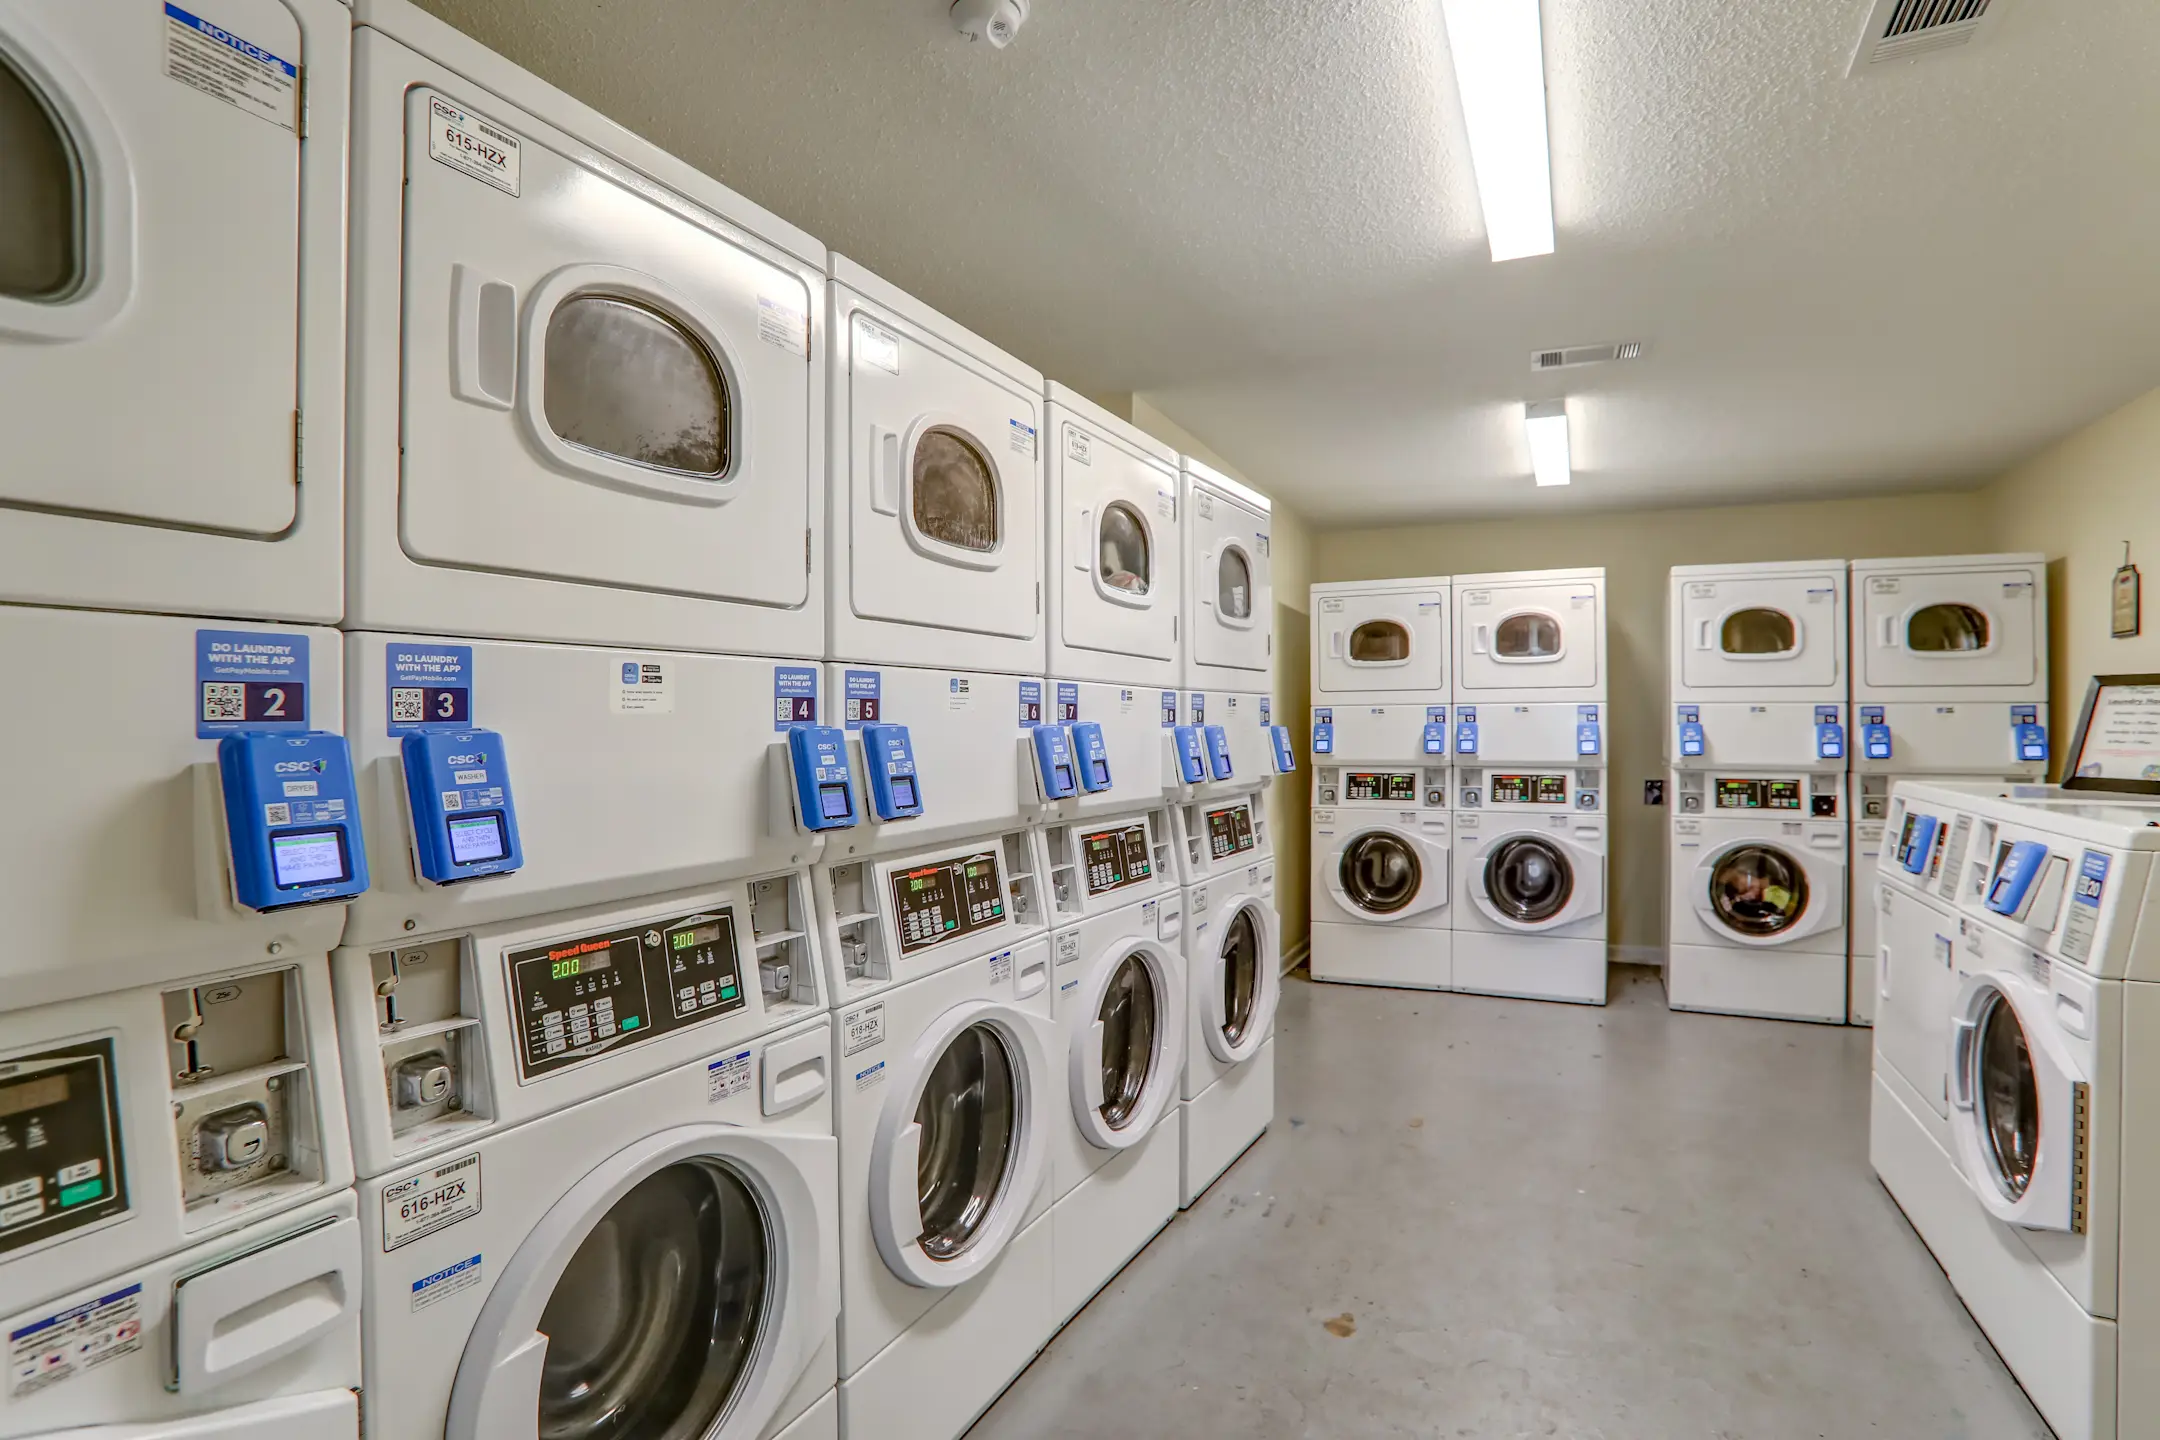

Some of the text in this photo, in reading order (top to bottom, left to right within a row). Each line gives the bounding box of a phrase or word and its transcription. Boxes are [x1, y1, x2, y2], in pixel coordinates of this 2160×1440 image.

[198, 20, 270, 63] NOTICE
[433, 102, 457, 118] CSC
[446, 128, 507, 168] 615-HZX
[212, 642, 291, 655] DO LAUNDRY
[208, 652, 295, 666] WITH THE APP
[398, 654, 458, 664] DO LAUNDRY
[214, 666, 290, 676] GetPayMobile.com
[395, 663, 461, 673] WITH THE APP
[400, 674, 457, 682] GetPayMobile.com
[263, 688, 285, 717] 2
[437, 692, 454, 718] 3
[798, 701, 808, 718] 4
[866, 702, 873, 718] 5
[1031, 706, 1036, 719] 6
[1069, 706, 1074, 718] 7
[1169, 710, 1174, 722] 8
[1198, 711, 1202, 721] 9
[274, 761, 309, 773] CSC
[448, 755, 474, 764] CSC
[457, 772, 484, 780] WASHER
[286, 784, 315, 792] DRYER
[2088, 880, 2100, 897] 20
[548, 940, 610, 960] Speed Queen
[552, 959, 579, 979] 2.00
[851, 1019, 879, 1038] 618-HZX
[386, 1182, 412, 1198] CSC
[400, 1180, 466, 1218] 616-HZX
[422, 1258, 474, 1288] NOTICE
